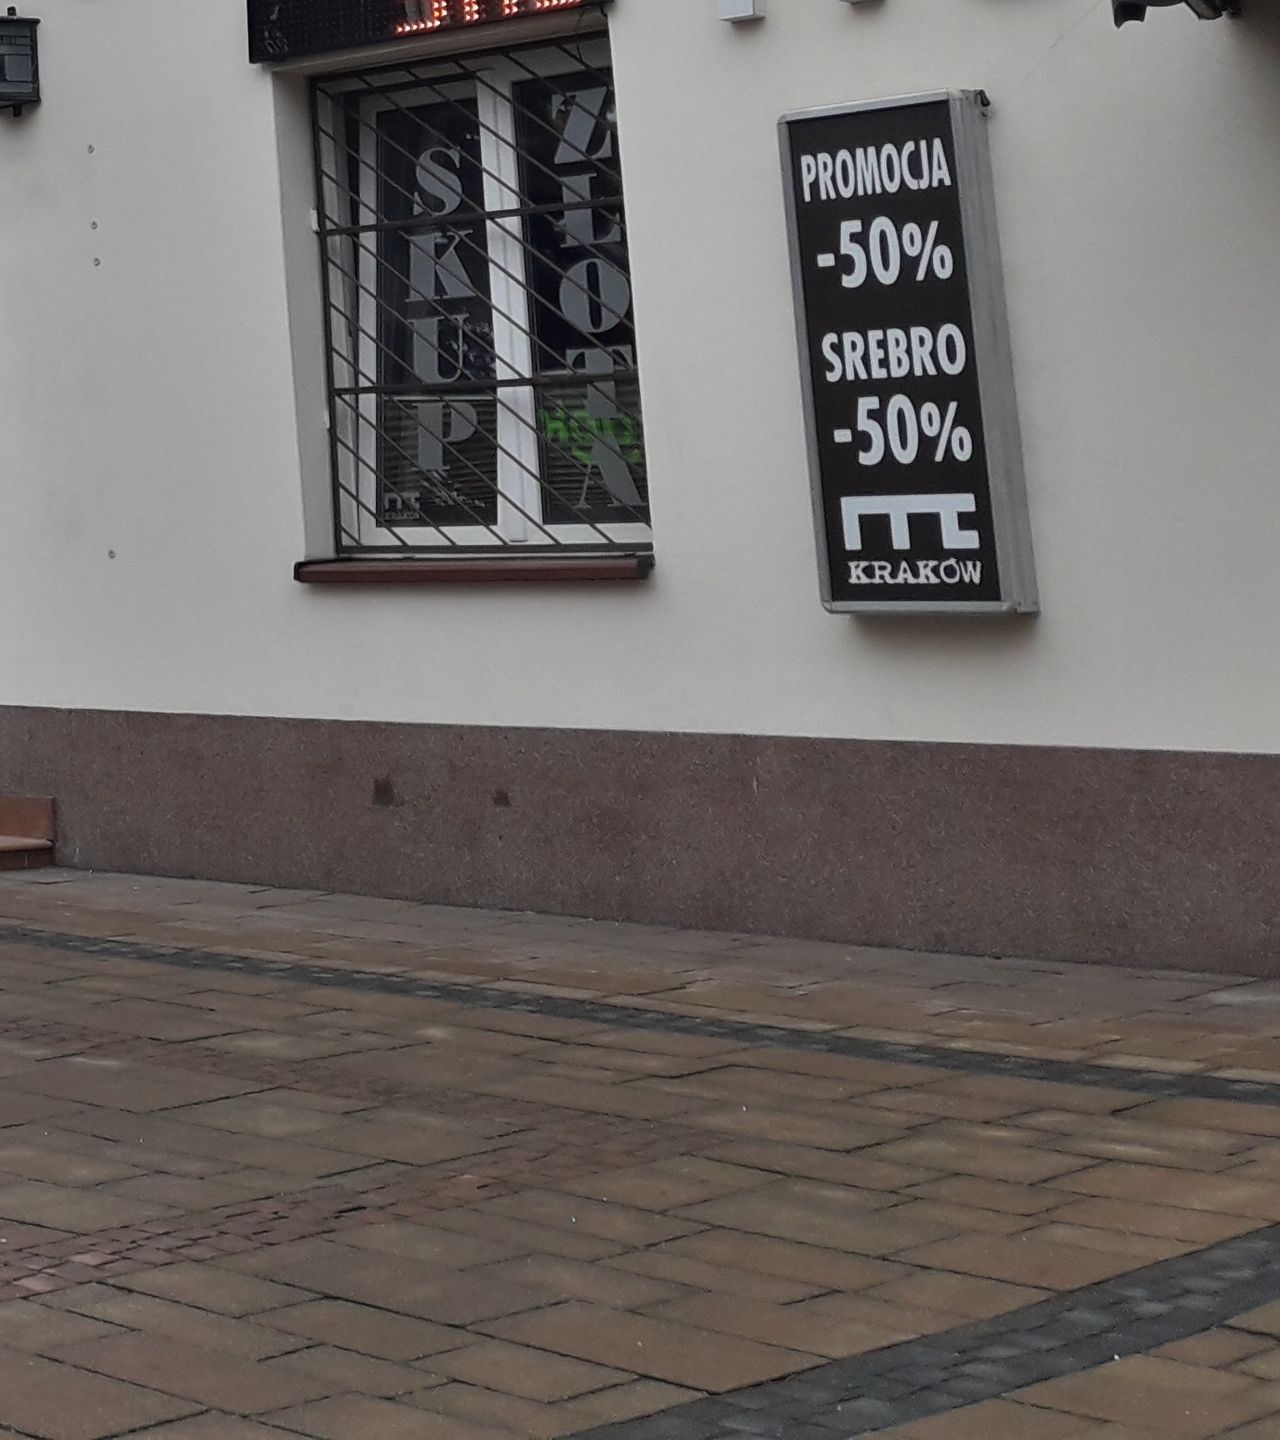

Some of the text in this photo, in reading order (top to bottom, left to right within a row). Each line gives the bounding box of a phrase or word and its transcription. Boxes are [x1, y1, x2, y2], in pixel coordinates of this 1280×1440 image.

[800, 136, 952, 203] PROMOCJA
[816, 215, 954, 289] -50%
[404, 145, 479, 472] SKUP
[821, 323, 967, 383] SREBRO
[833, 393, 973, 466] -50%
[847, 557, 983, 586] KRAKÓW
